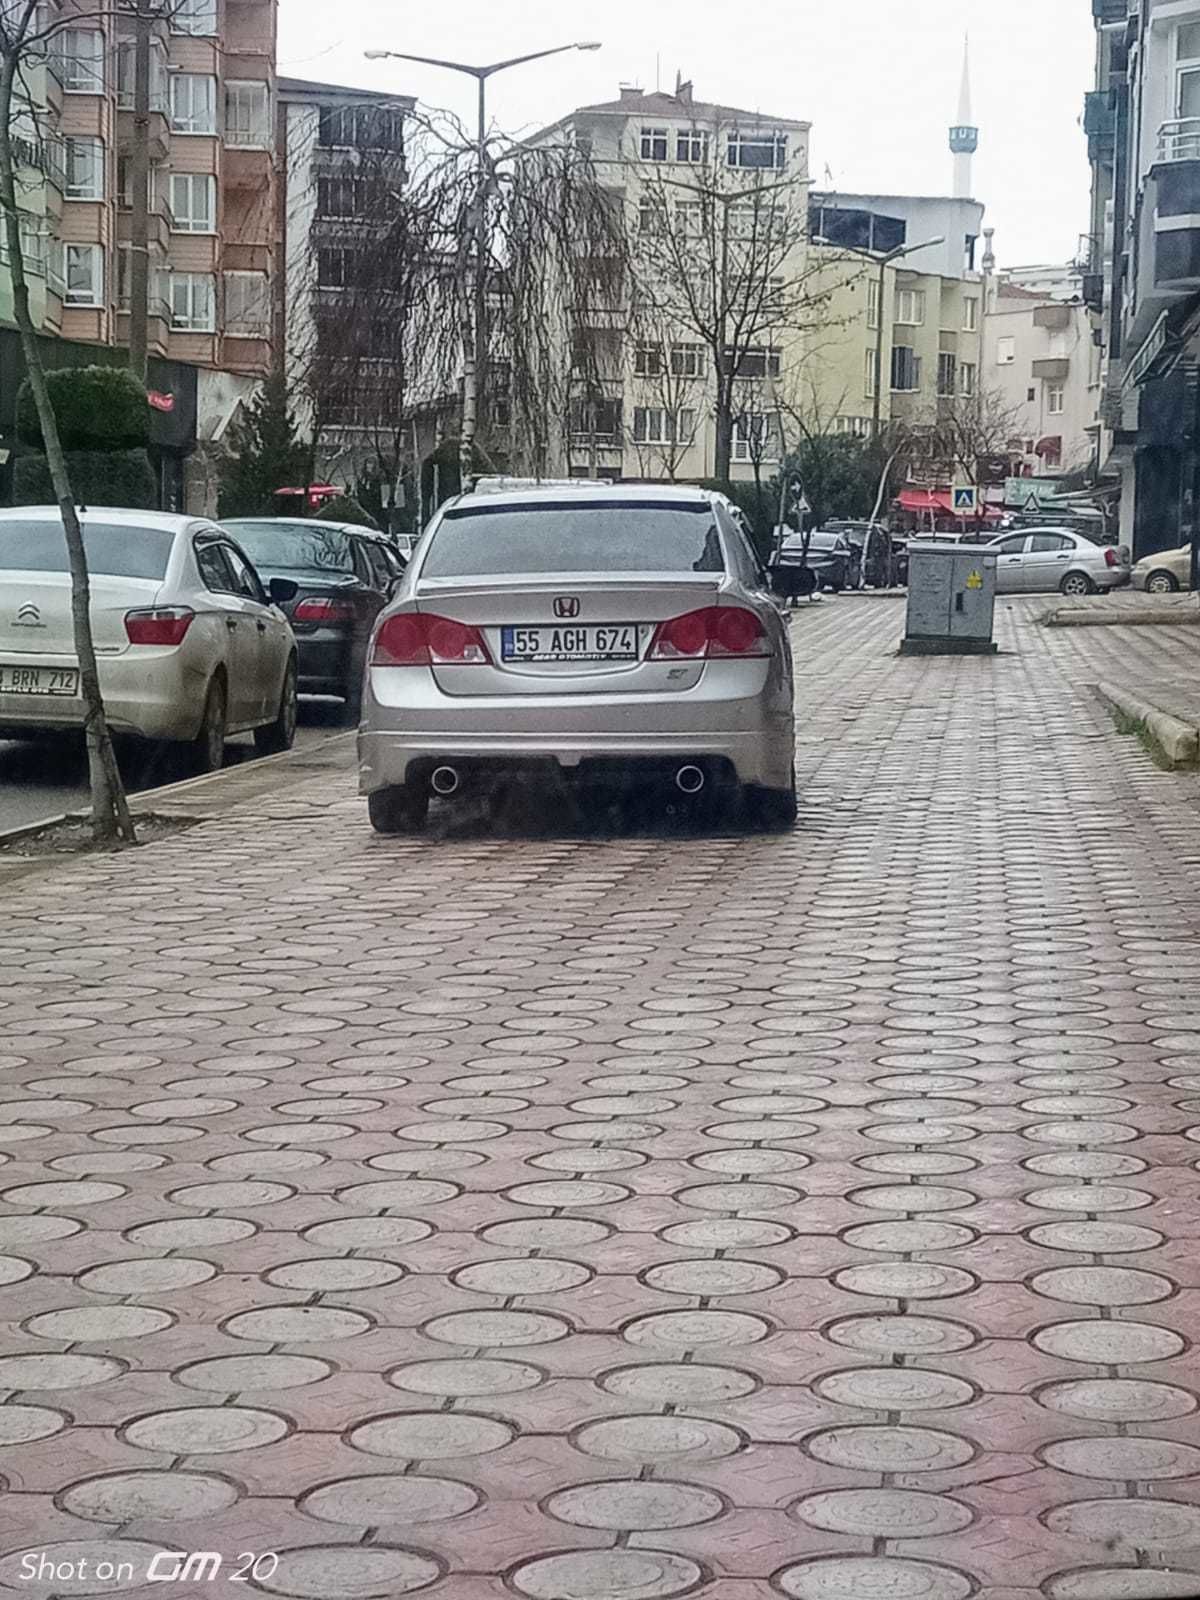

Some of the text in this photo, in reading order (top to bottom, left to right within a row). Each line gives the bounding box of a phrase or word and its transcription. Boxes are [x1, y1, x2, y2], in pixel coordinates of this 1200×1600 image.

[516, 630, 540, 652] 55
[551, 629, 587, 651] AGH
[596, 628, 632, 651] 674
[12, 670, 40, 686] BRN
[49, 671, 74, 688] 712
